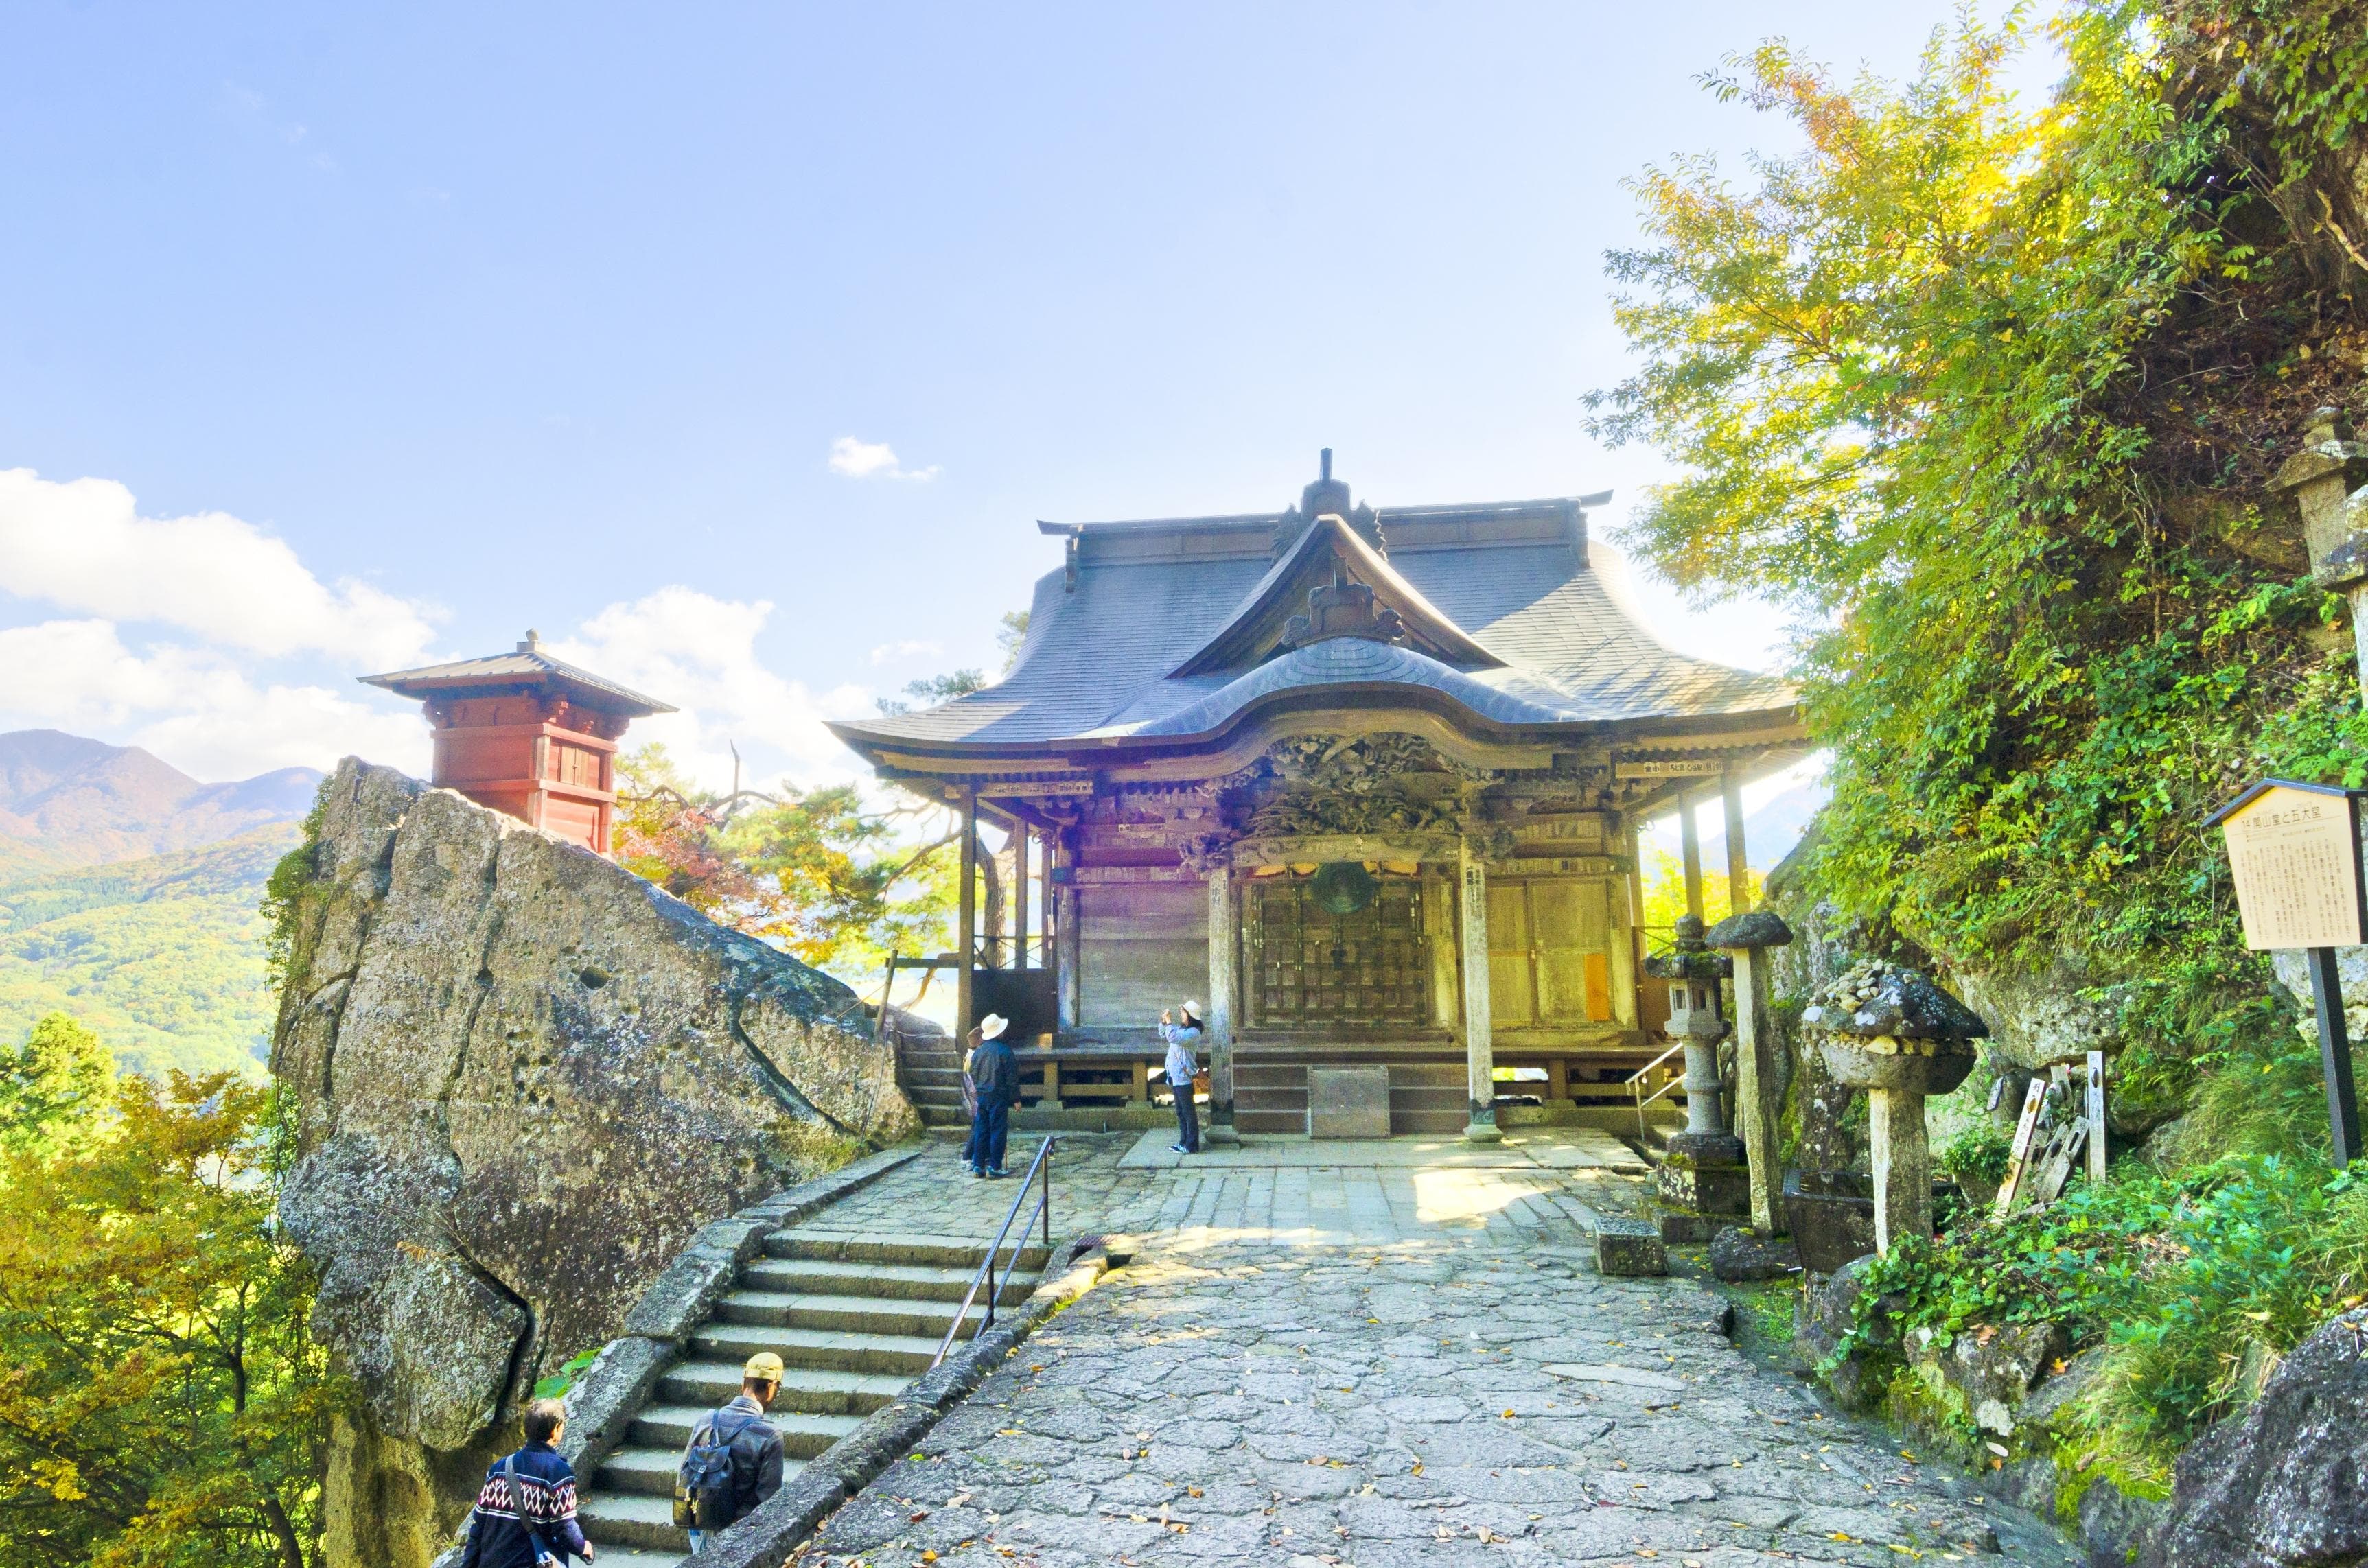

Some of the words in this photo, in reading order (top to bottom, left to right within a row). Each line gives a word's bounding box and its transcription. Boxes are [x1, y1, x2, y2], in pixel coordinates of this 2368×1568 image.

[2253, 806, 2321, 829] 開山堂と五大堂
